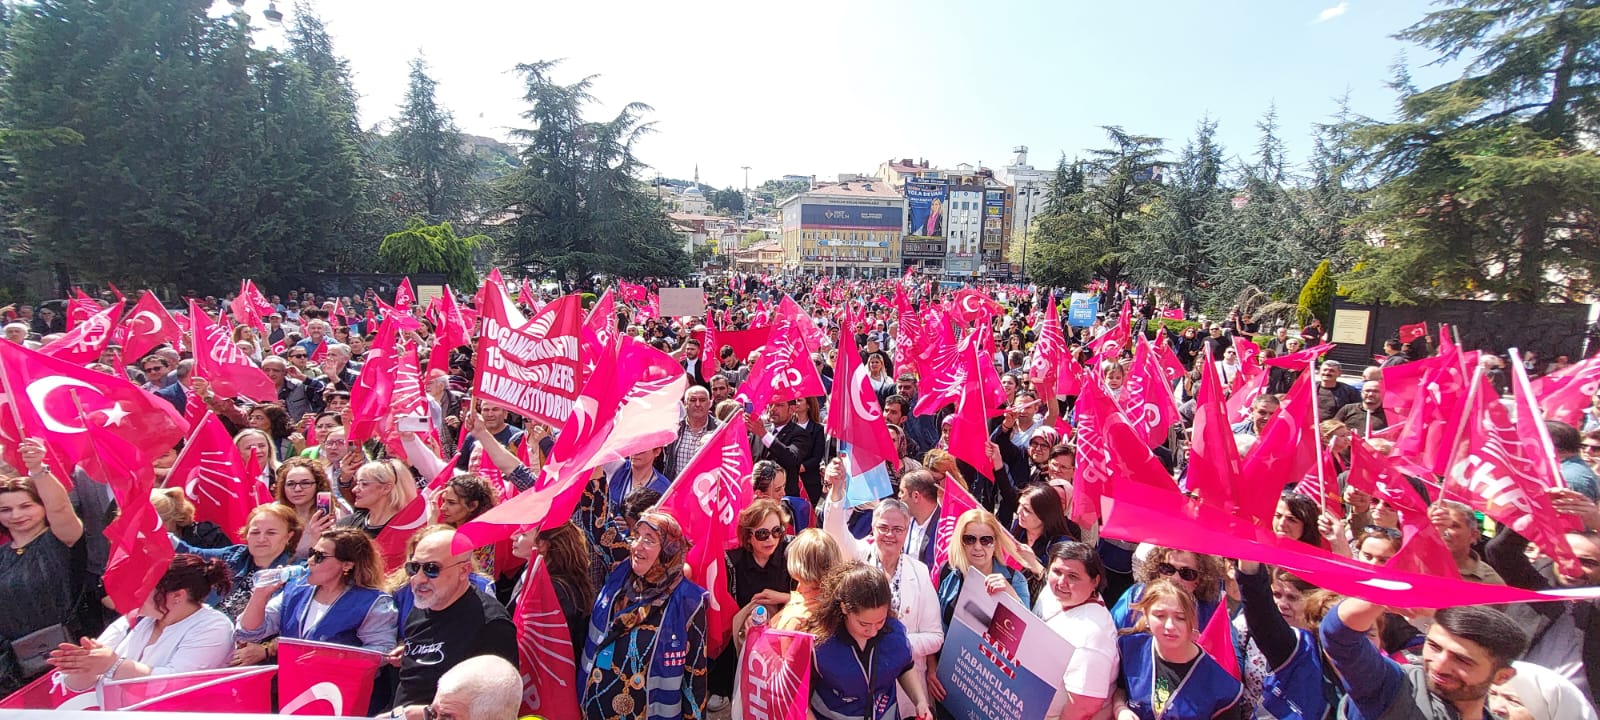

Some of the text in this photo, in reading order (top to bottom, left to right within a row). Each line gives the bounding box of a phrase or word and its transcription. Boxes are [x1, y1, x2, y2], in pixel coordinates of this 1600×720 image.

[486, 346, 505, 370] 15
[480, 371, 526, 406] ALMAK
[1451, 454, 1533, 514] CHP
[957, 656, 976, 677] KONUT
[984, 633, 1018, 667] SANA
[961, 646, 1024, 713] YABANCILARA
